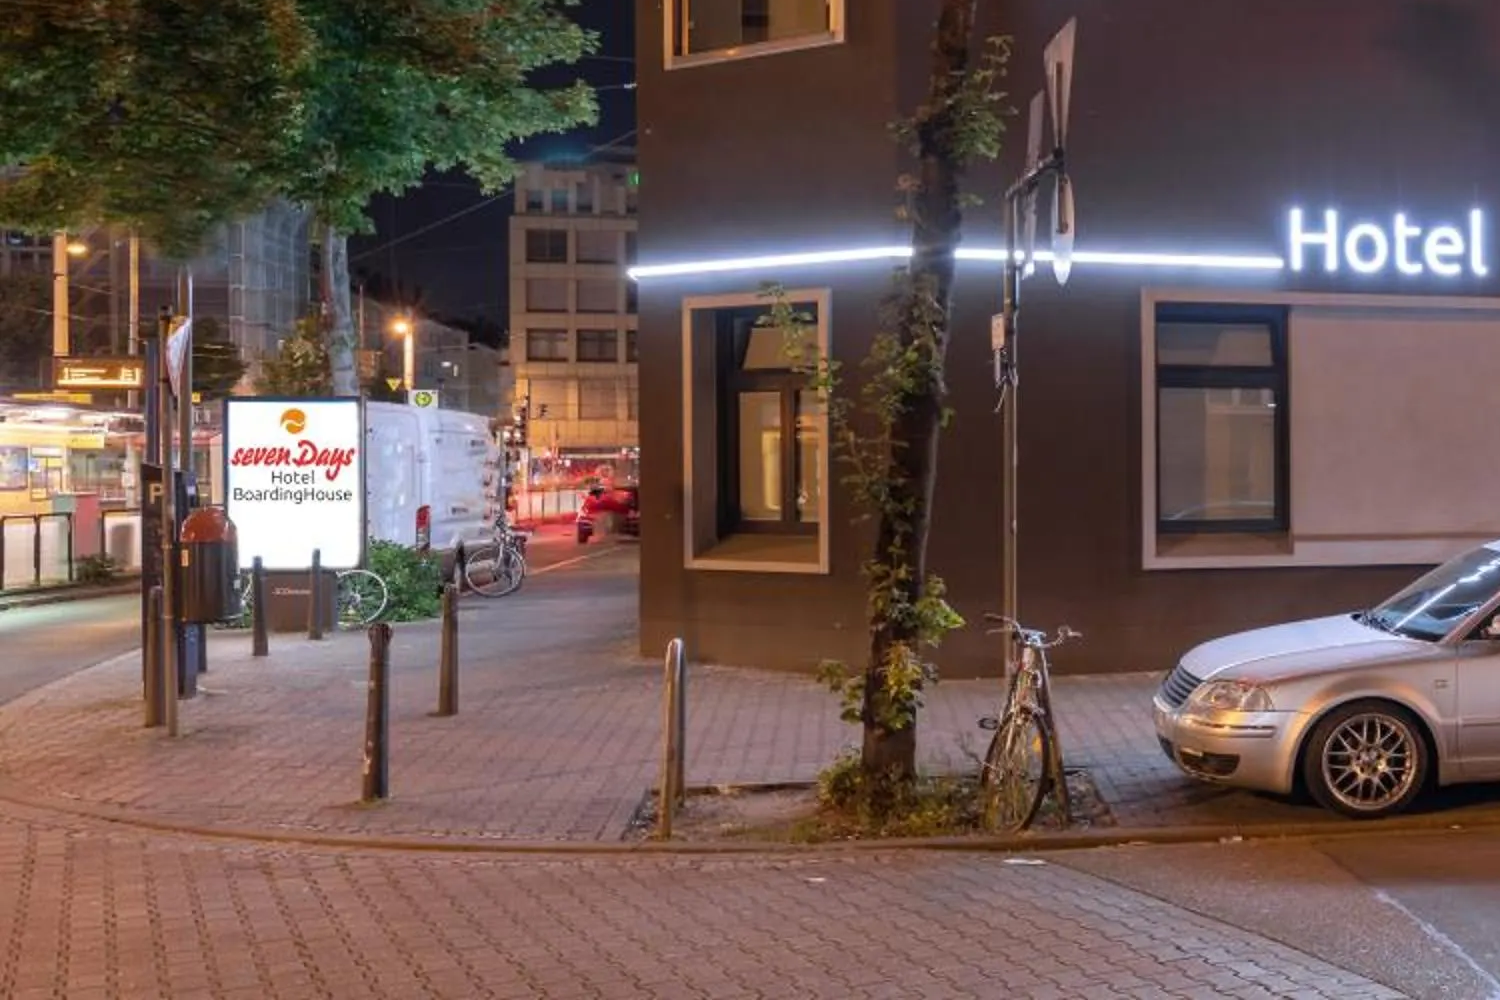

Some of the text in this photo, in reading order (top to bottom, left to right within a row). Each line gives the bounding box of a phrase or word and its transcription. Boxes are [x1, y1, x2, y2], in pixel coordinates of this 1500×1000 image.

[1288, 208, 1488, 276] Hotel
[271, 469, 315, 485] Hotel
[233, 487, 353, 505] BoardingHouse
